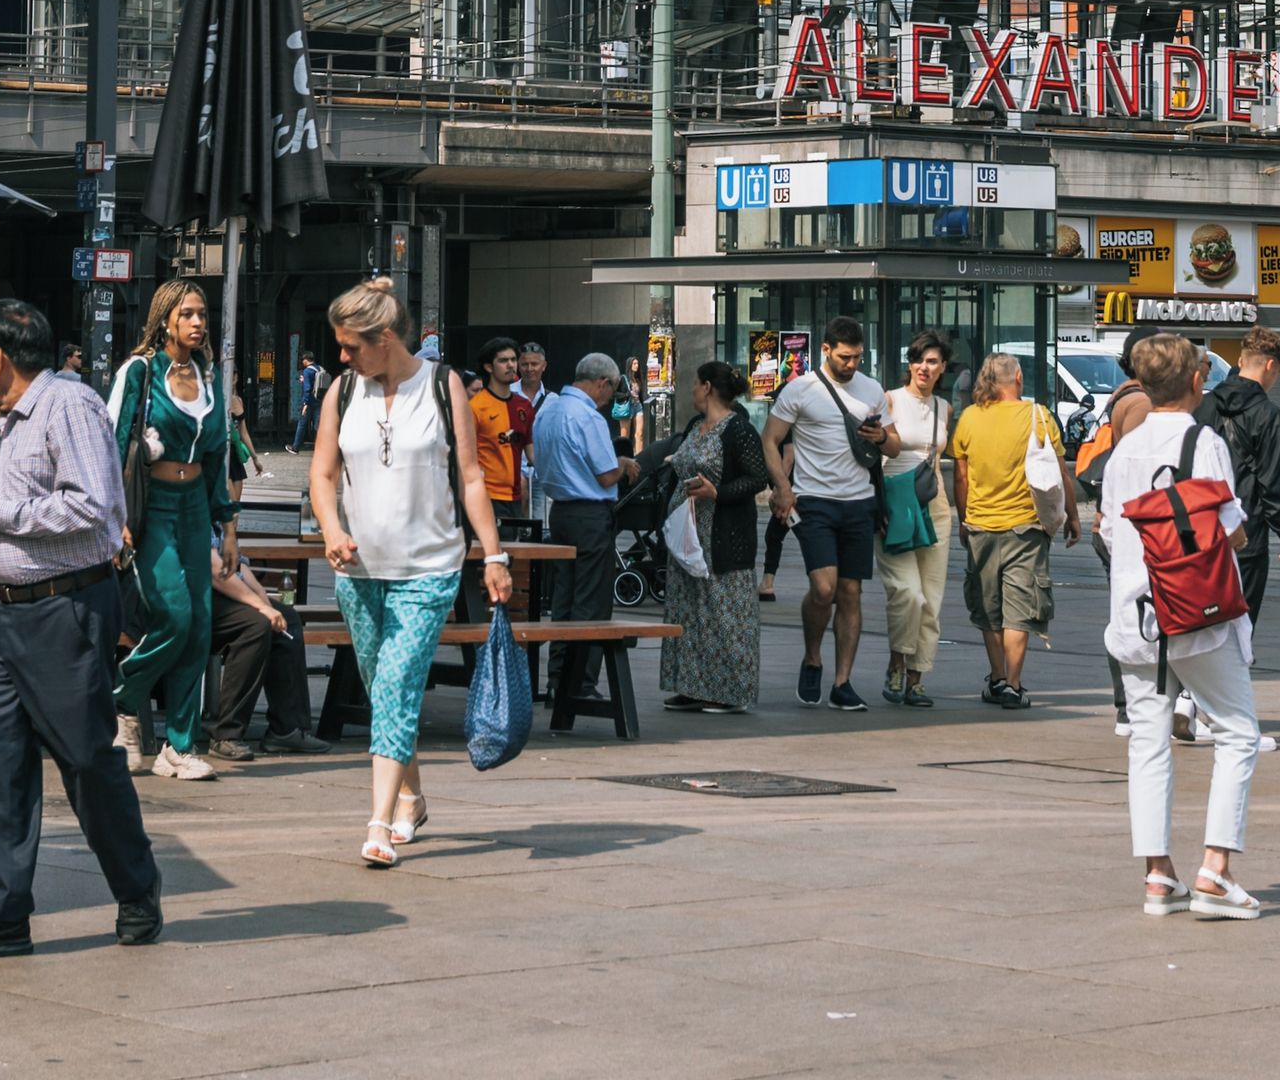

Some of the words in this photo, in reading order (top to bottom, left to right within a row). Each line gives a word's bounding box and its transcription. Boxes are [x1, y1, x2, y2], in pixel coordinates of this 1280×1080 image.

[720, 168, 740, 207] U
[775, 168, 790, 184] U8
[892, 162, 917, 202] U
[980, 168, 997, 183] U8
[775, 188, 790, 203] U5
[980, 188, 997, 203] U5
[1099, 229, 1154, 247] BURGER
[1126, 246, 1170, 261] MITTE?
[1260, 246, 1279, 259] ICH
[958, 260, 967, 275] U
[974, 261, 1054, 278] Alexanderplatz
[1261, 272, 1279, 285] ES!
[1136, 298, 1258, 323] McDonald's
